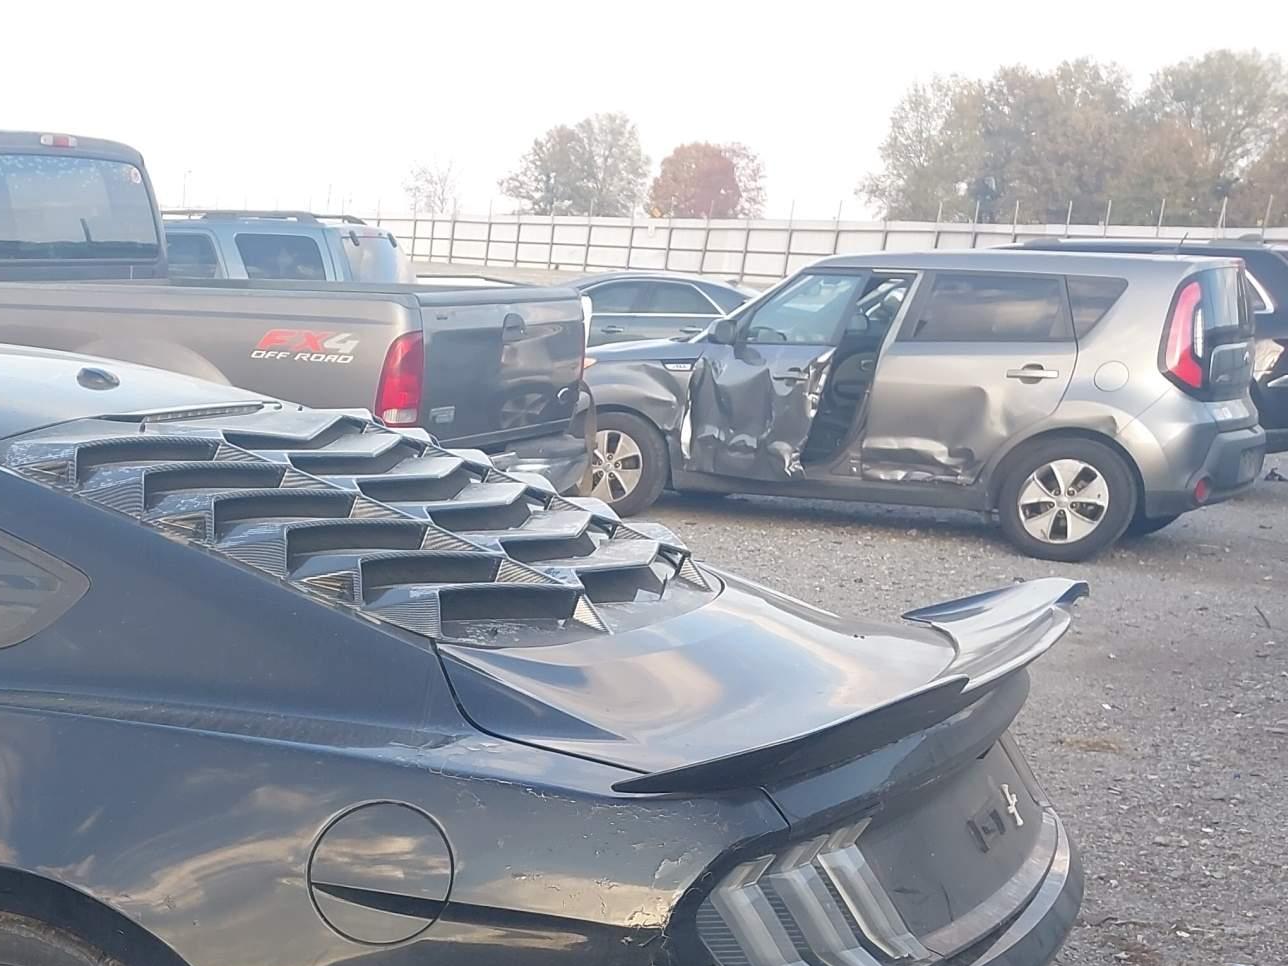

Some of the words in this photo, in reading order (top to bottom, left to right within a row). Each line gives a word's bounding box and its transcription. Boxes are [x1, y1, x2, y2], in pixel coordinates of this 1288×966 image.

[256, 328, 360, 354] FX4
[250, 349, 291, 360] OFF
[293, 351, 355, 364] ROAD
